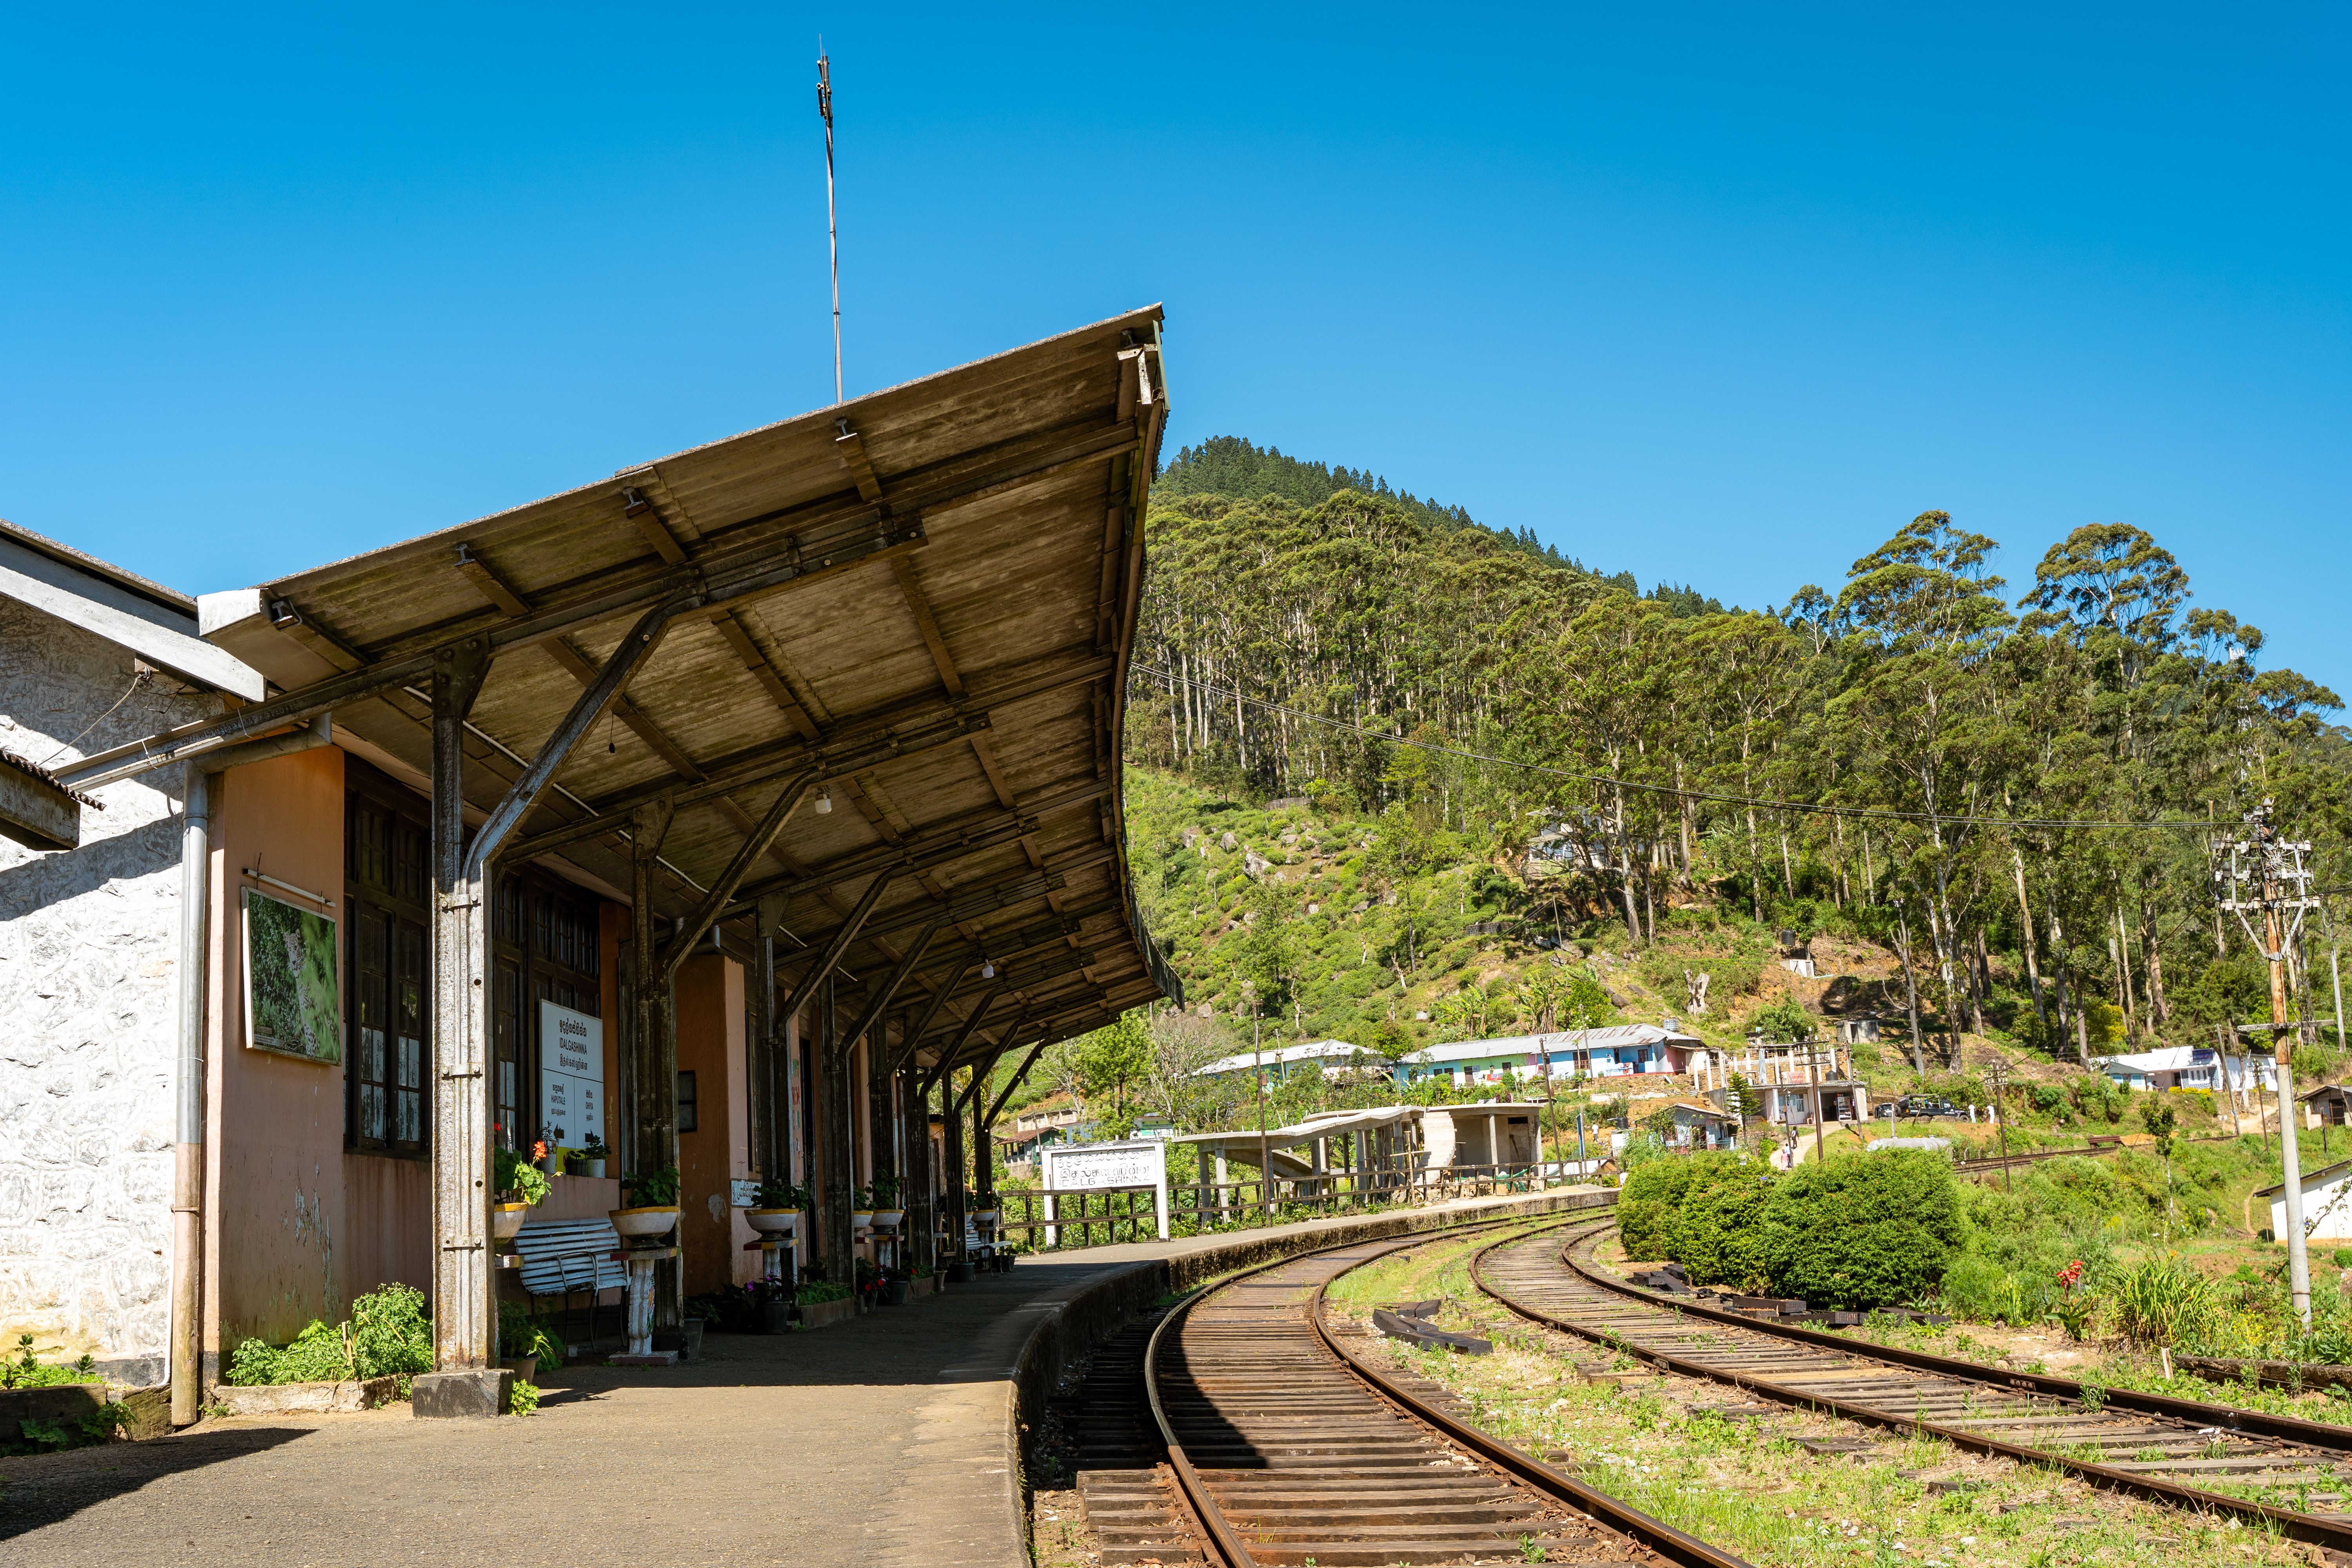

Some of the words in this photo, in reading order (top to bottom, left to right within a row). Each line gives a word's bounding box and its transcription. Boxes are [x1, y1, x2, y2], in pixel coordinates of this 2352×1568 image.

[559, 1037, 587, 1055] IDALGASHINNA
[551, 1095, 566, 1105] HAPUTALE
[1059, 1175, 1150, 1187] IDALGASHINNA
